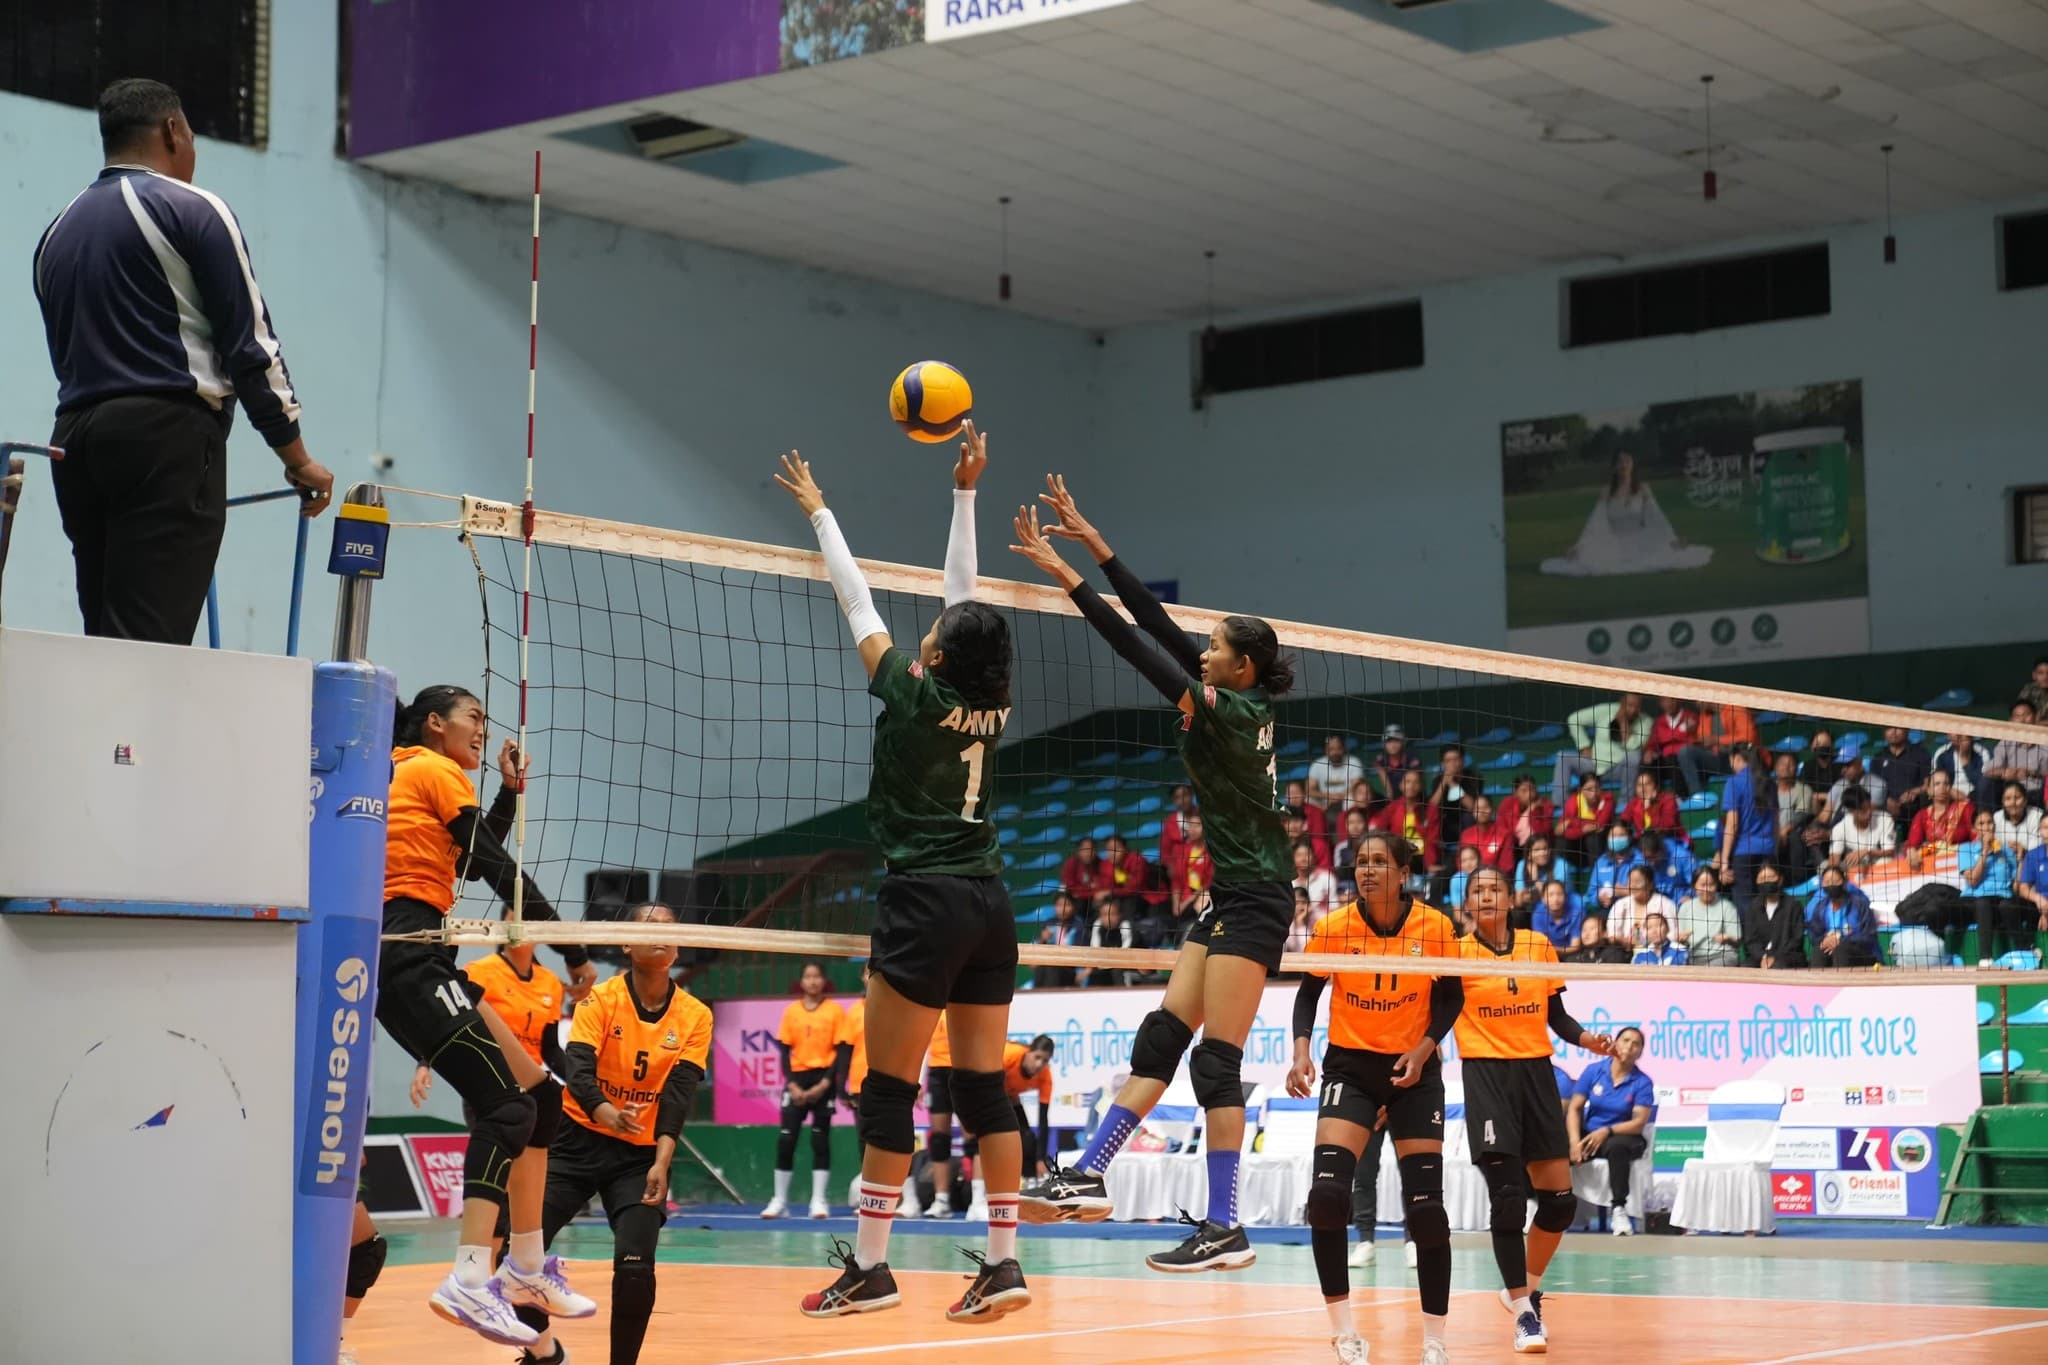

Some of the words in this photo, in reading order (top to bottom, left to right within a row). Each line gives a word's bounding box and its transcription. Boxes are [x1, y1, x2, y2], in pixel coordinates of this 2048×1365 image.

[960, 741, 984, 823] 1
[435, 980, 473, 1017] 14
[1506, 977, 1519, 996] 4
[1478, 1001, 1542, 1019] Mahindr
[740, 1029, 784, 1053] KN
[1860, 1016, 1919, 1057] २०८२
[632, 1050, 649, 1082] 5
[739, 1056, 785, 1086] NE
[315, 1007, 360, 1183] Senoh
[1321, 1082, 1344, 1107] 11
[1484, 1119, 1496, 1145] 4
[1848, 1175, 1901, 1190] Oriental
